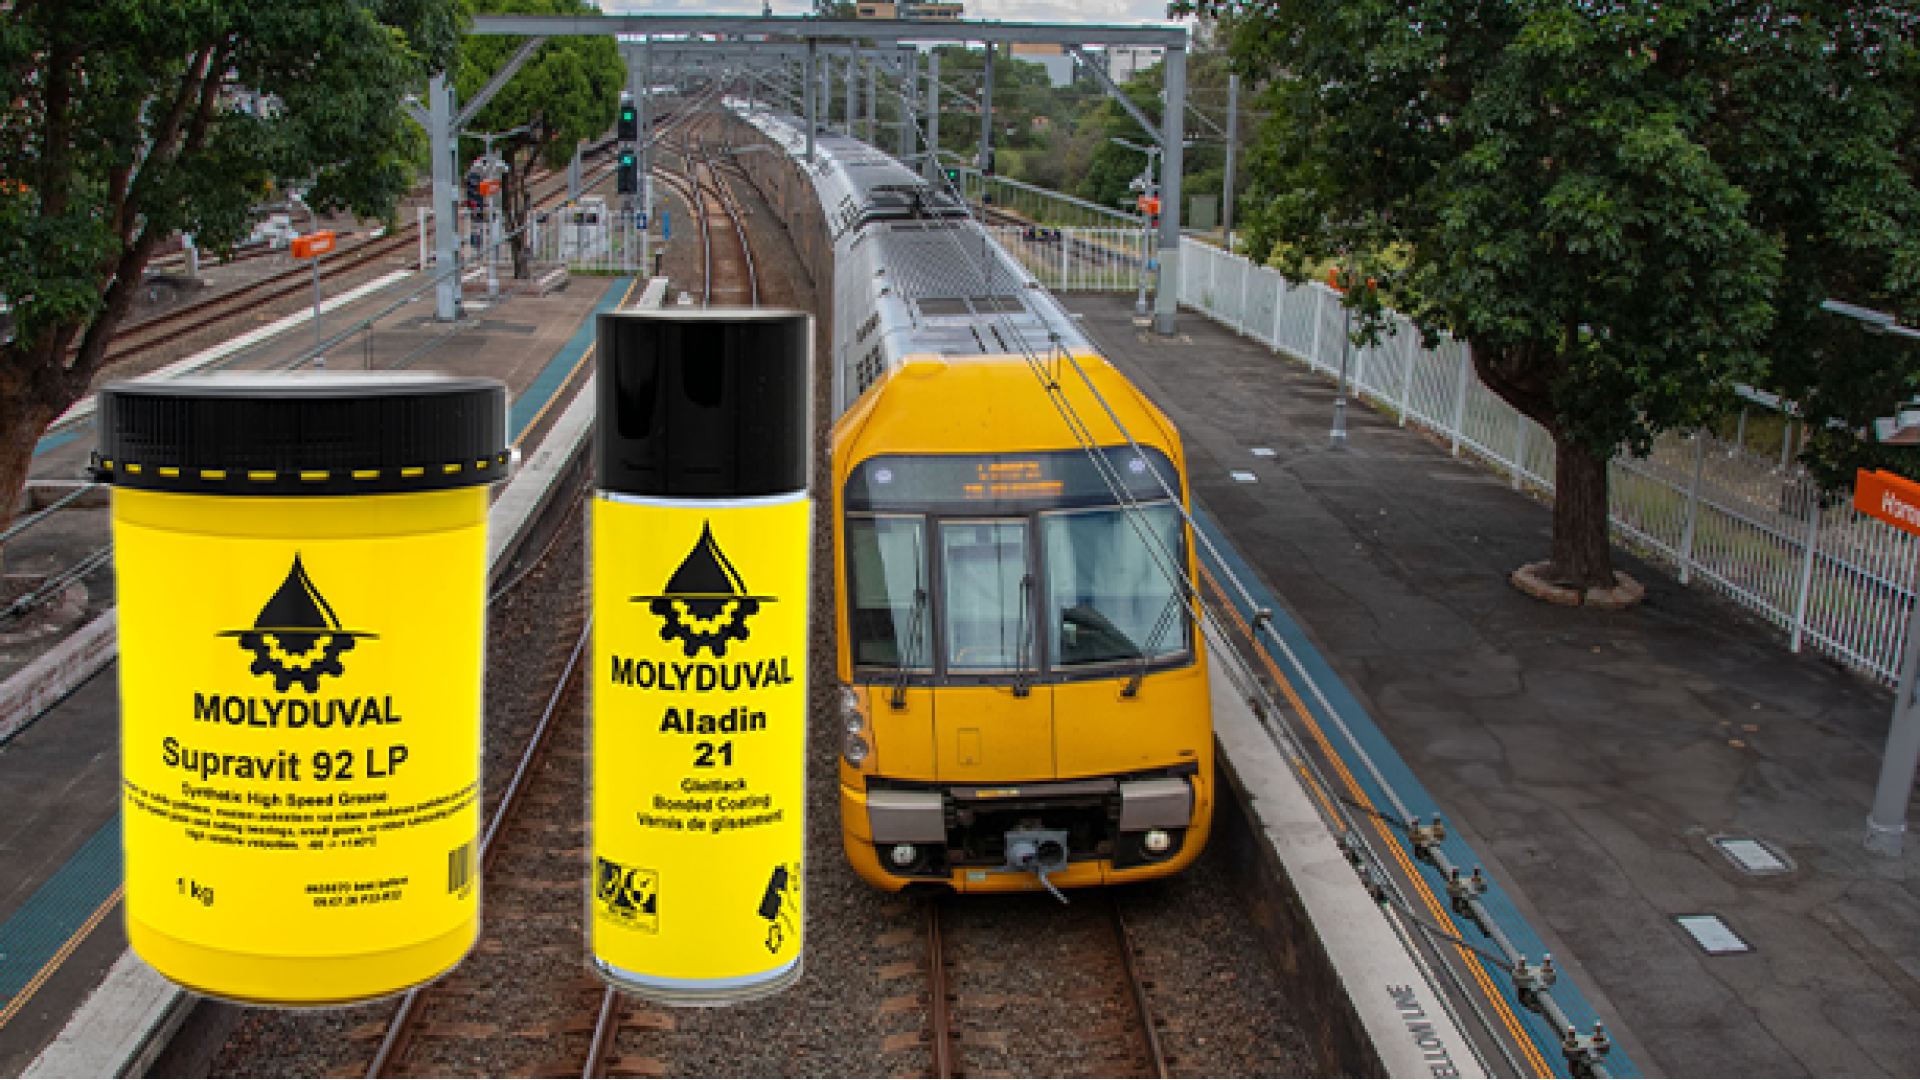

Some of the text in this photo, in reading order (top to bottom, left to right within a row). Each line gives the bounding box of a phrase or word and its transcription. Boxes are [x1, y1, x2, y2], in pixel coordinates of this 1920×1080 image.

[611, 655, 794, 692] MOLYDUVAL
[194, 692, 402, 728] MOLYDUVAL
[659, 706, 766, 734] Aladin
[163, 737, 408, 781] Supravit 92 LP
[693, 742, 732, 767] 21
[248, 792, 281, 808] High
[286, 793, 333, 809] Speed
[190, 878, 214, 907] kg
[1386, 984, 1425, 1019] LINE
